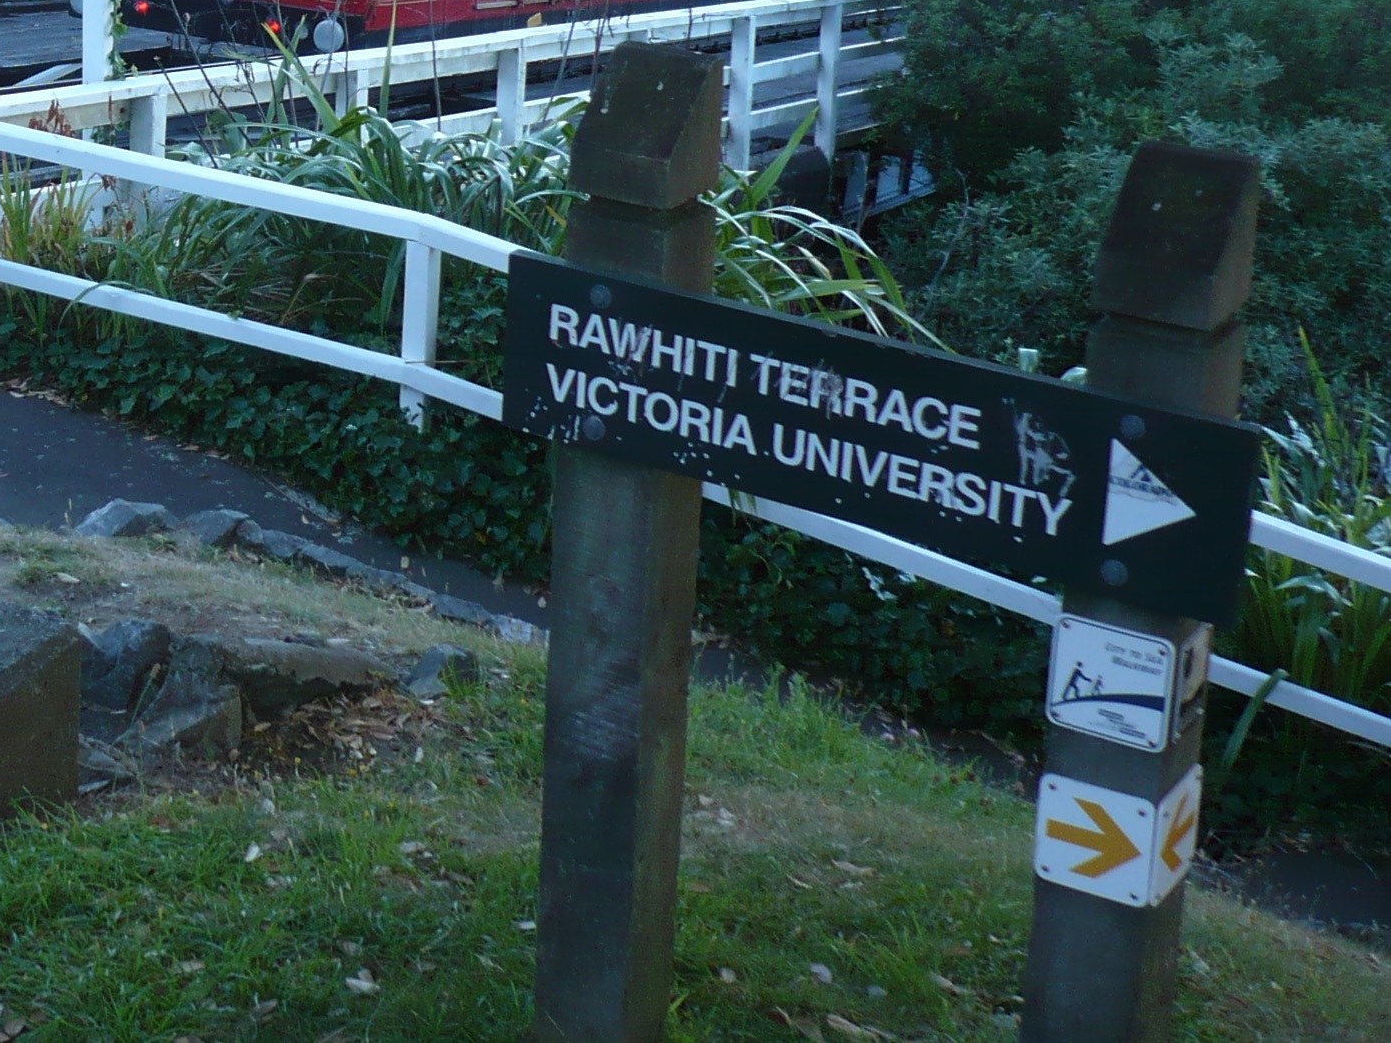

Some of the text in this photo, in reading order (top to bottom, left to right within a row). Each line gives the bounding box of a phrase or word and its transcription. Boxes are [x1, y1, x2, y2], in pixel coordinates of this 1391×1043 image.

[546, 362, 1073, 536] VICTORIA UNIVERSITY
[548, 303, 982, 450] RAWHITI TERRACE
